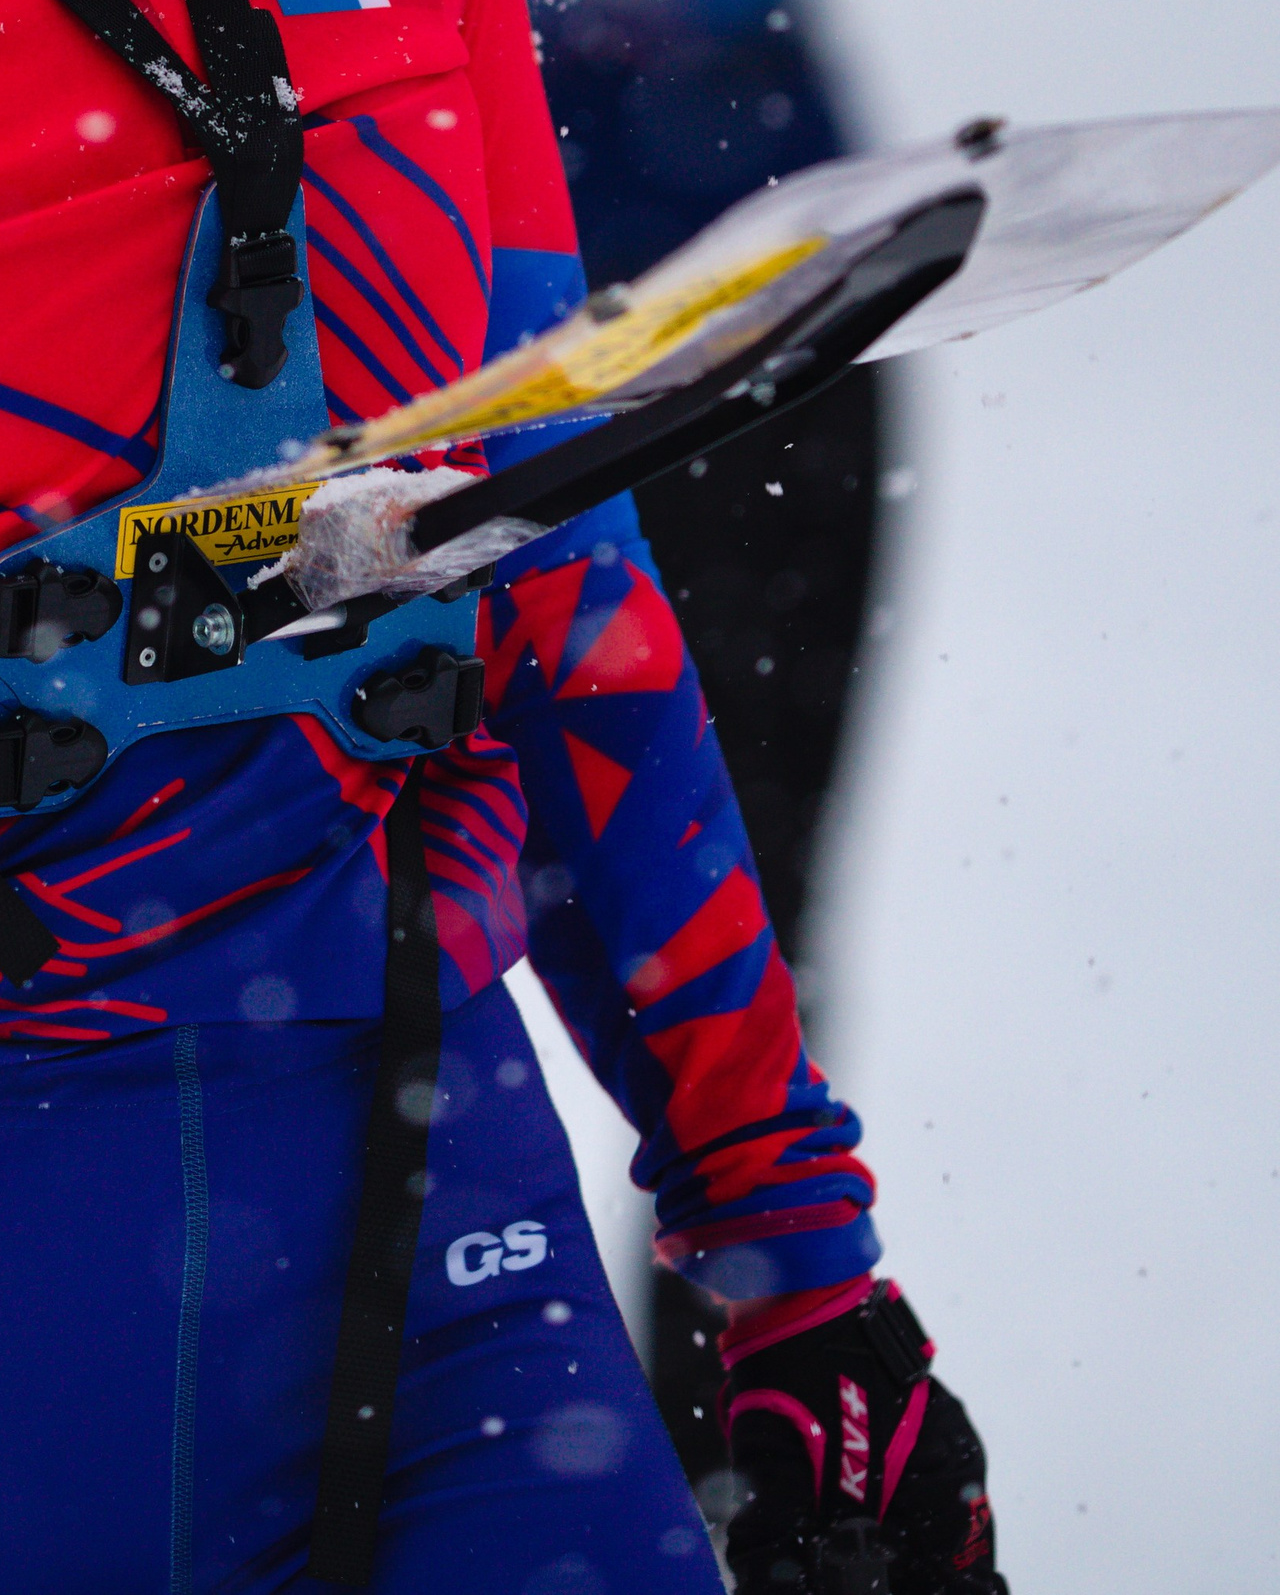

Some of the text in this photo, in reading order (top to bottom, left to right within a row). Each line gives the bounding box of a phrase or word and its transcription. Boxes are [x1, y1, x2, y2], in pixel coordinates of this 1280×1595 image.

[129, 495, 306, 545] NORDENM
[215, 531, 299, 556] Adven
[445, 1219, 548, 1287] GS
